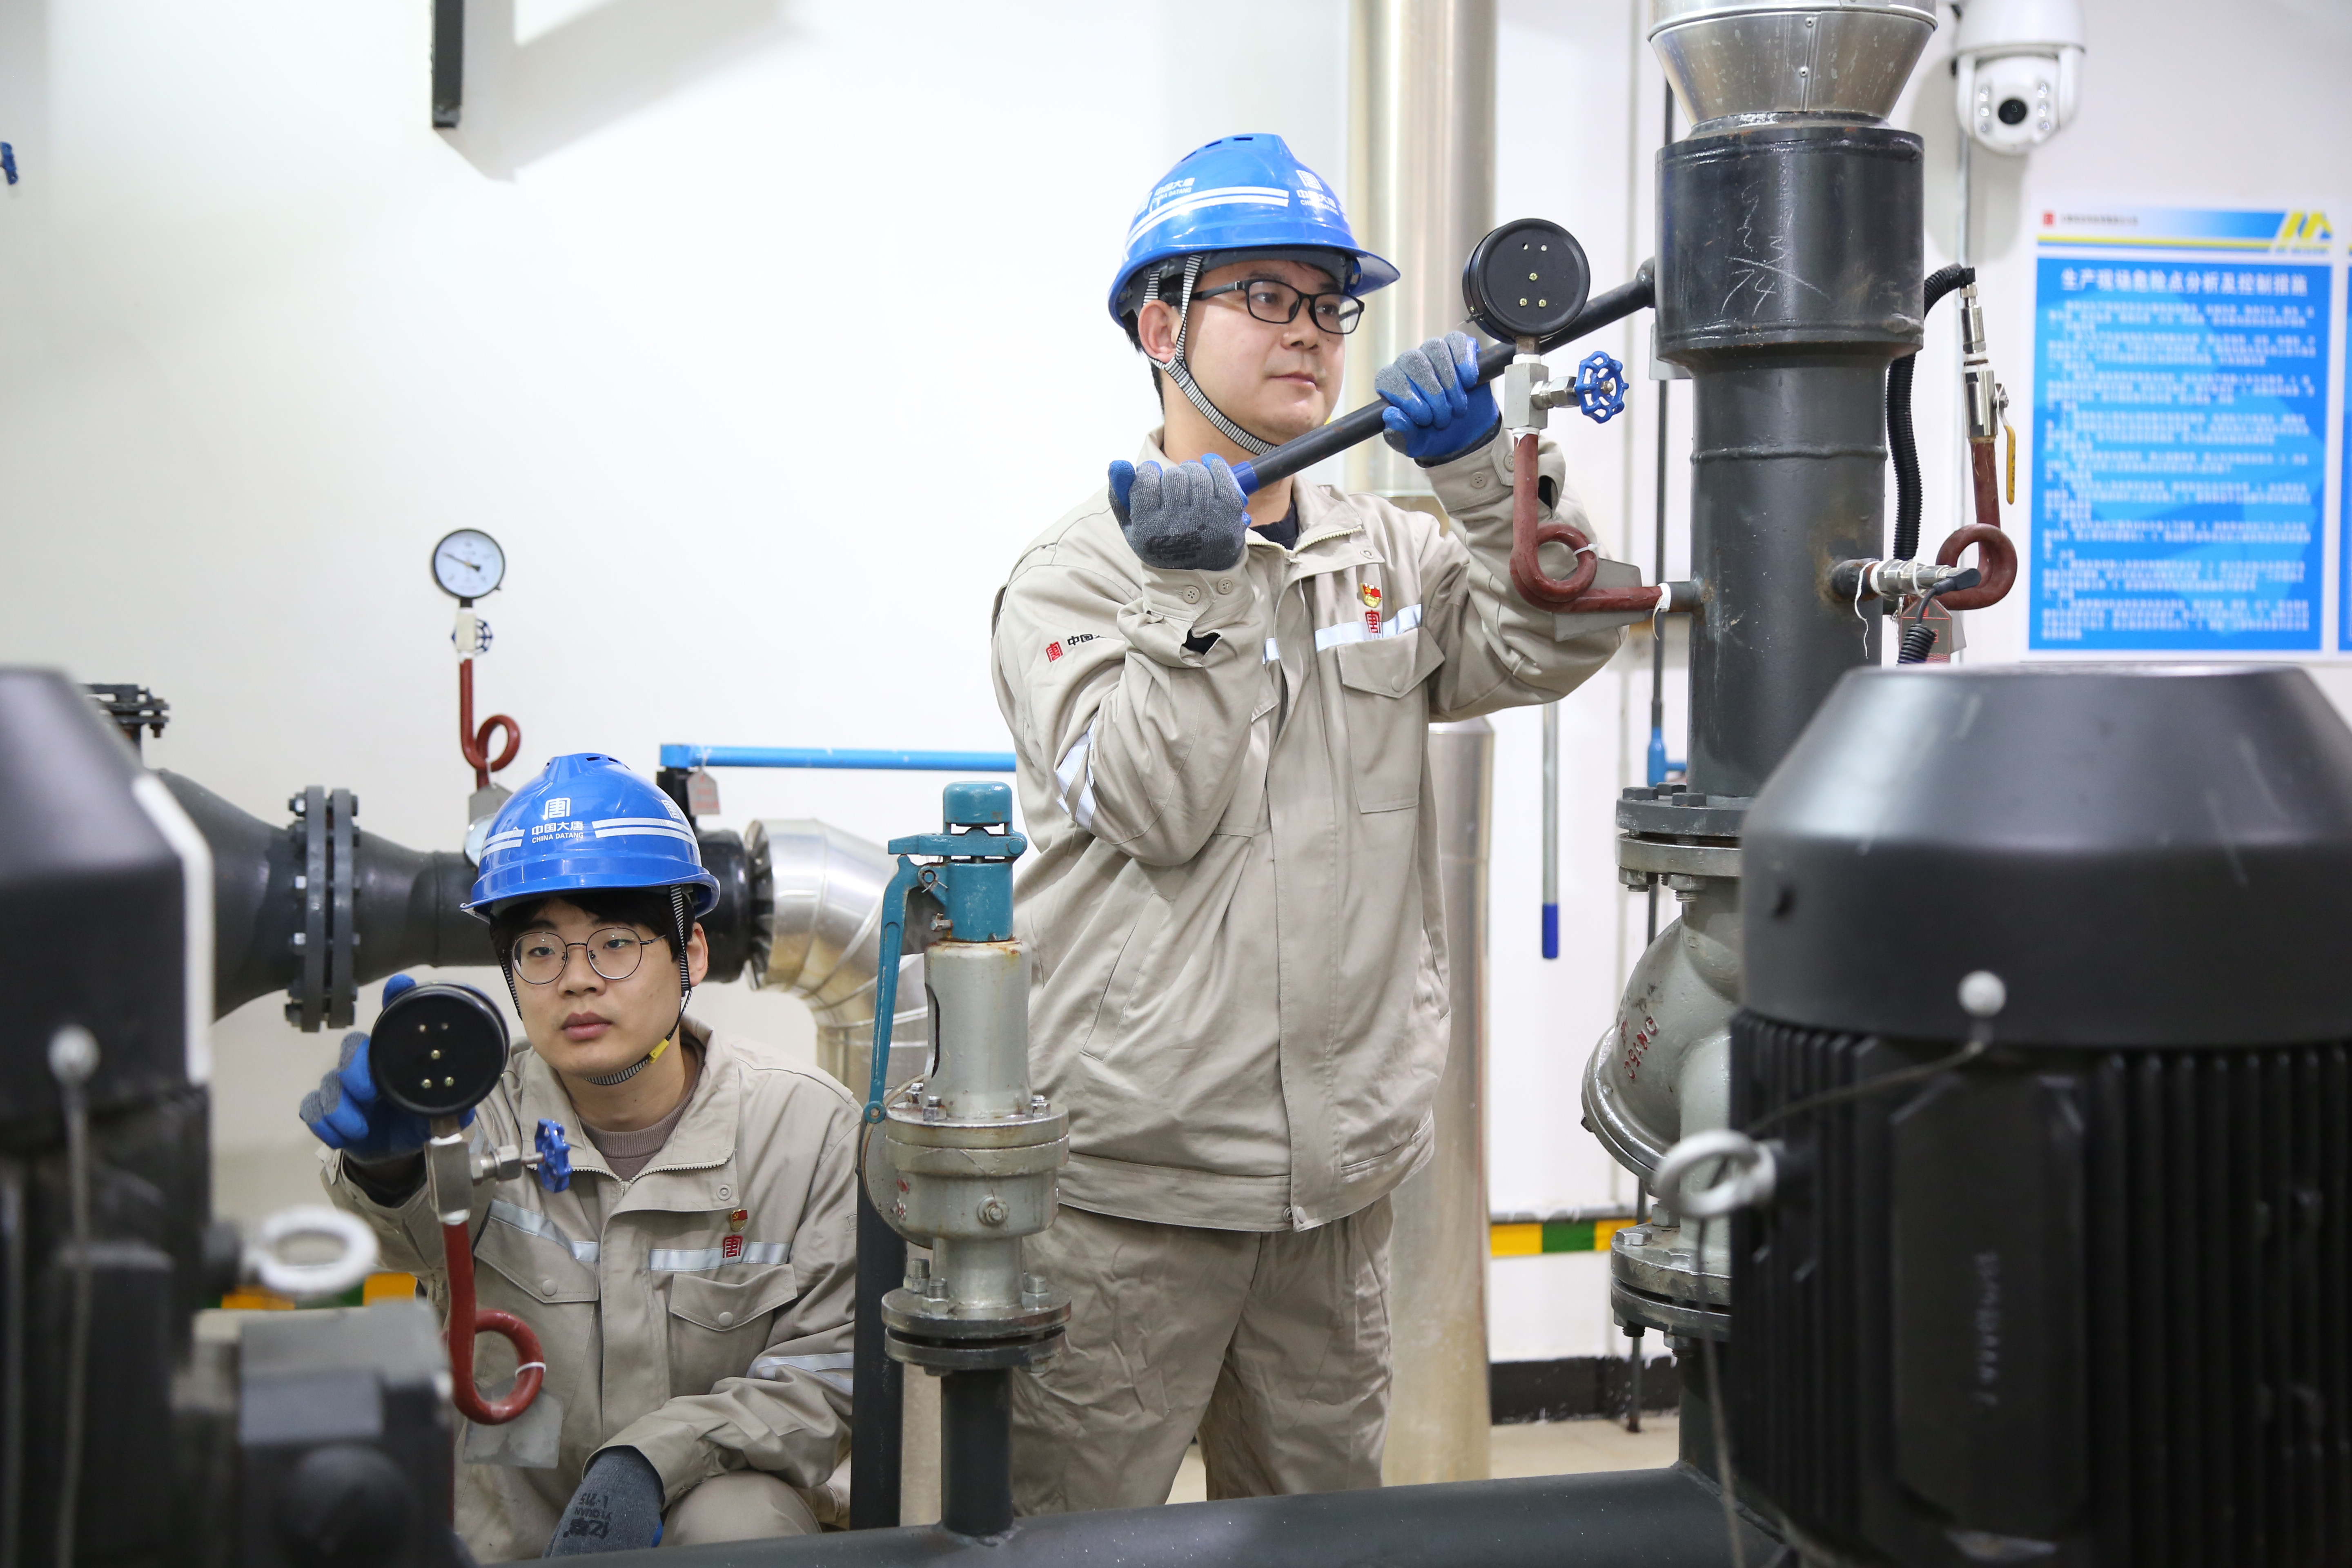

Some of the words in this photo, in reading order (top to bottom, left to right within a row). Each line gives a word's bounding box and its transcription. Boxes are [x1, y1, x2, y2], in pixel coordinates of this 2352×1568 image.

[1168, 187, 1192, 196] DATANG
[1296, 189, 1337, 209] 中大唐
[532, 821, 584, 835] 中国大唐
[532, 834, 553, 843] CHINA
